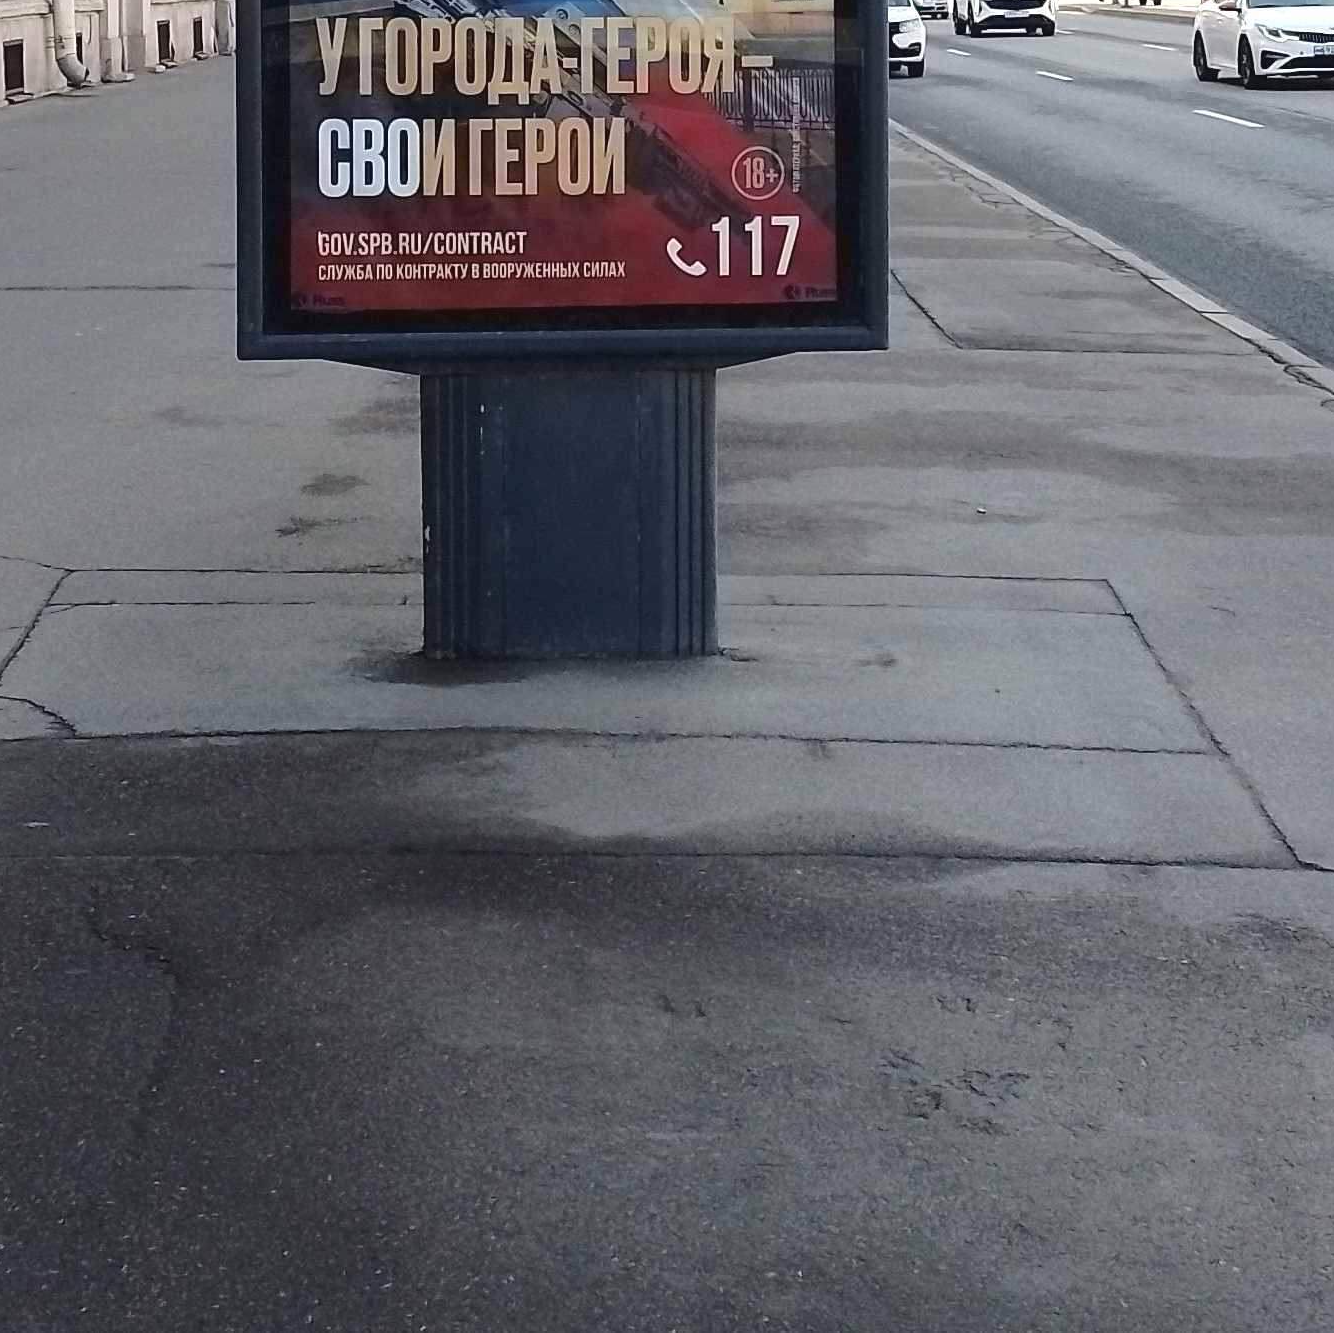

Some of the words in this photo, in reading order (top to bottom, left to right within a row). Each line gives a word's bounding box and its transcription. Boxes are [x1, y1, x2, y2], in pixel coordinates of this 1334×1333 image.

[315, 17, 347, 96] У
[318, 117, 456, 198] СВОИ
[468, 116, 626, 196] ГЕРОИ
[742, 157, 779, 189] 18+
[318, 231, 527, 256] GOV.SPB.RU/CONTRACT
[711, 215, 800, 276] 117
[318, 265, 373, 281] СЛУЖБА
[376, 264, 393, 280] ПО
[396, 263, 468, 280] КОНТРАКТУ
[471, 263, 480, 279] В
[483, 262, 581, 279] ВООРУЖЕННЫХ
[583, 261, 626, 278] СИЛАХ
